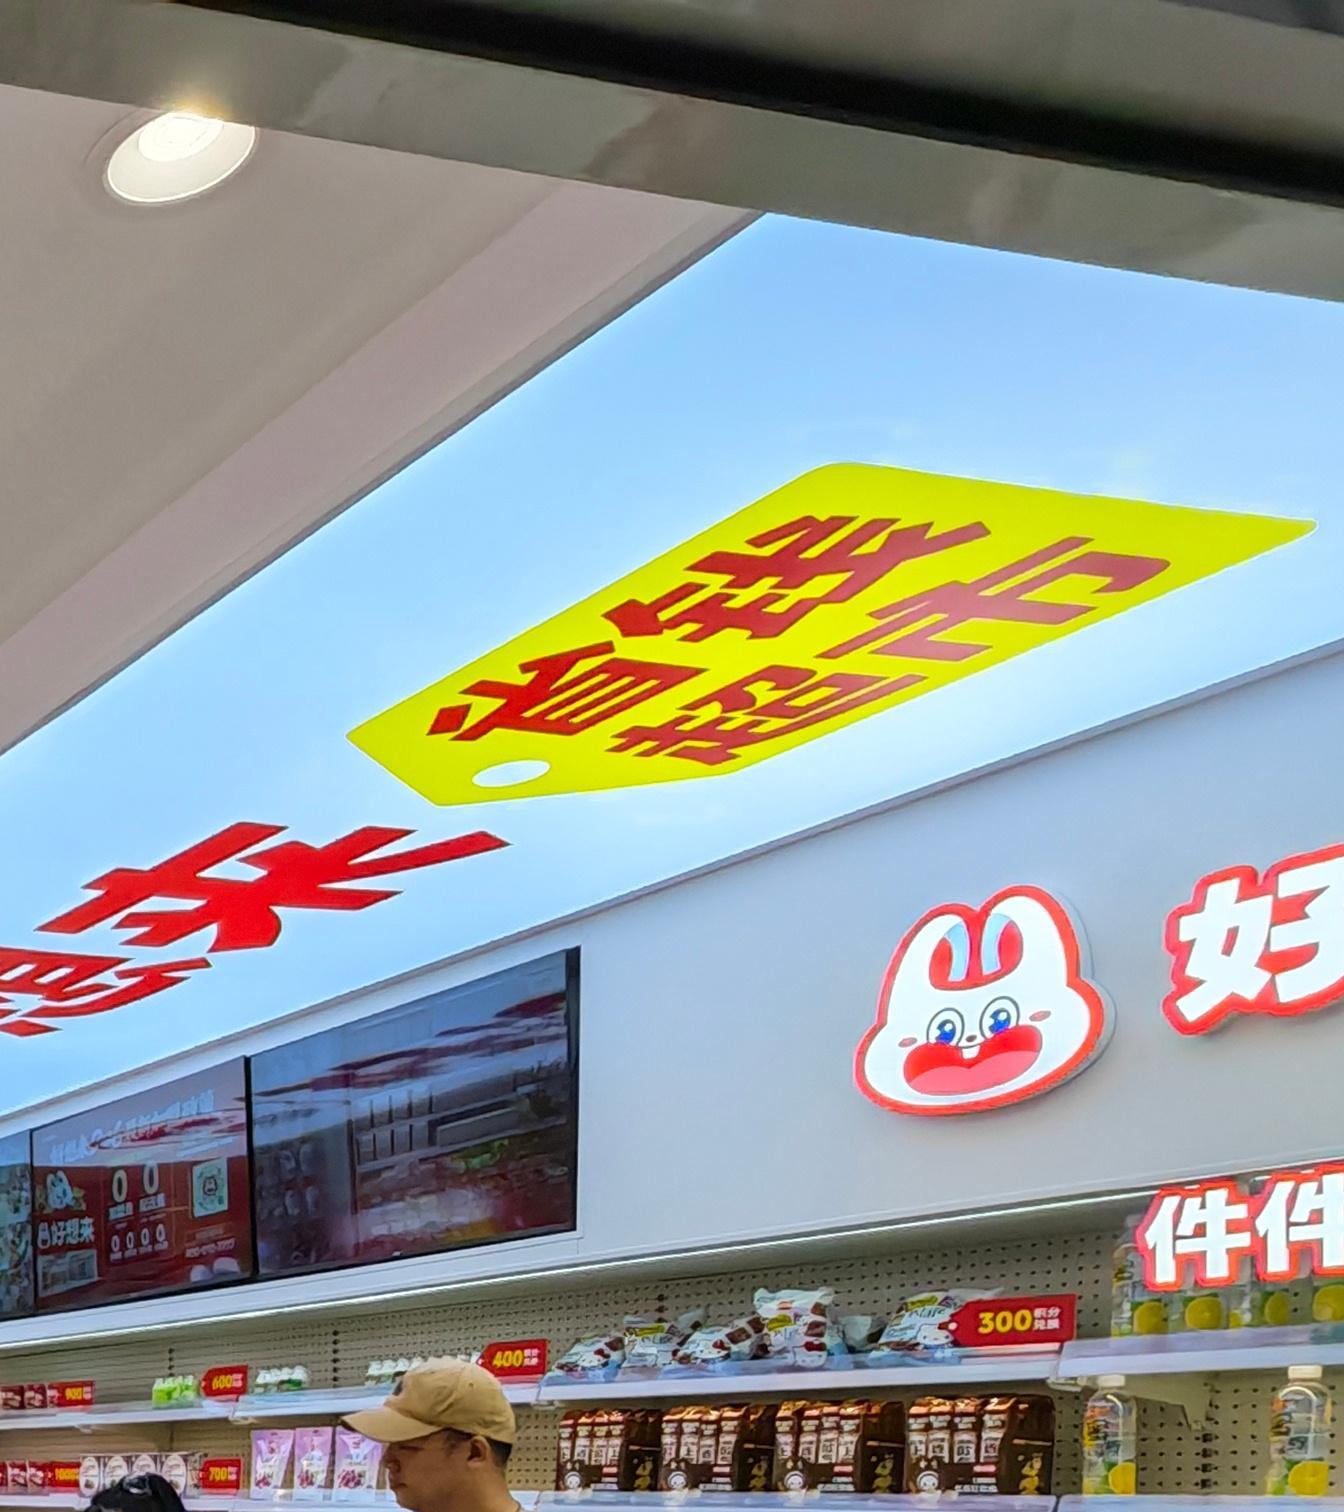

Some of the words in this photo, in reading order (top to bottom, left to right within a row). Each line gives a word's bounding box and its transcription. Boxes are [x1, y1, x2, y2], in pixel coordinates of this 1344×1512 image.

[426, 515, 992, 741] 省钱
[604, 536, 1172, 767] 超市
[1175, 855, 1344, 1022] 好
[1145, 1172, 1344, 1285] 件件
[978, 1309, 1032, 1334] 300
